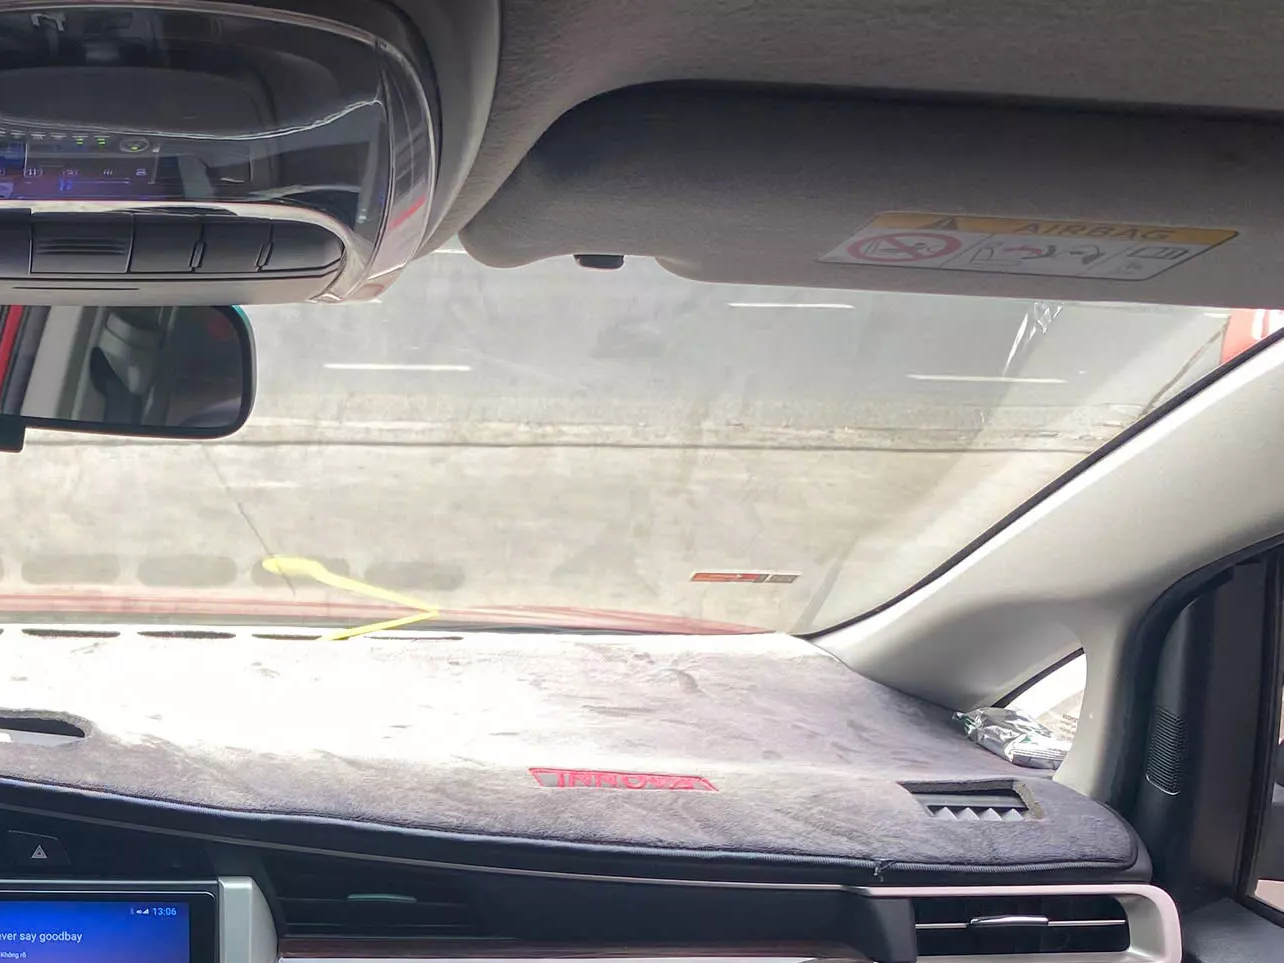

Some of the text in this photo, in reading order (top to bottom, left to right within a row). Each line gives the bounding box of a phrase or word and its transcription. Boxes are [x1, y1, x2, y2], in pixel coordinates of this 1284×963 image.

[1014, 222, 1175, 241] AIRBAG
[557, 770, 694, 790] INNOVA
[152, 907, 177, 916] 13:06
[19, 932, 37, 943] say
[39, 931, 83, 943] goodbay
